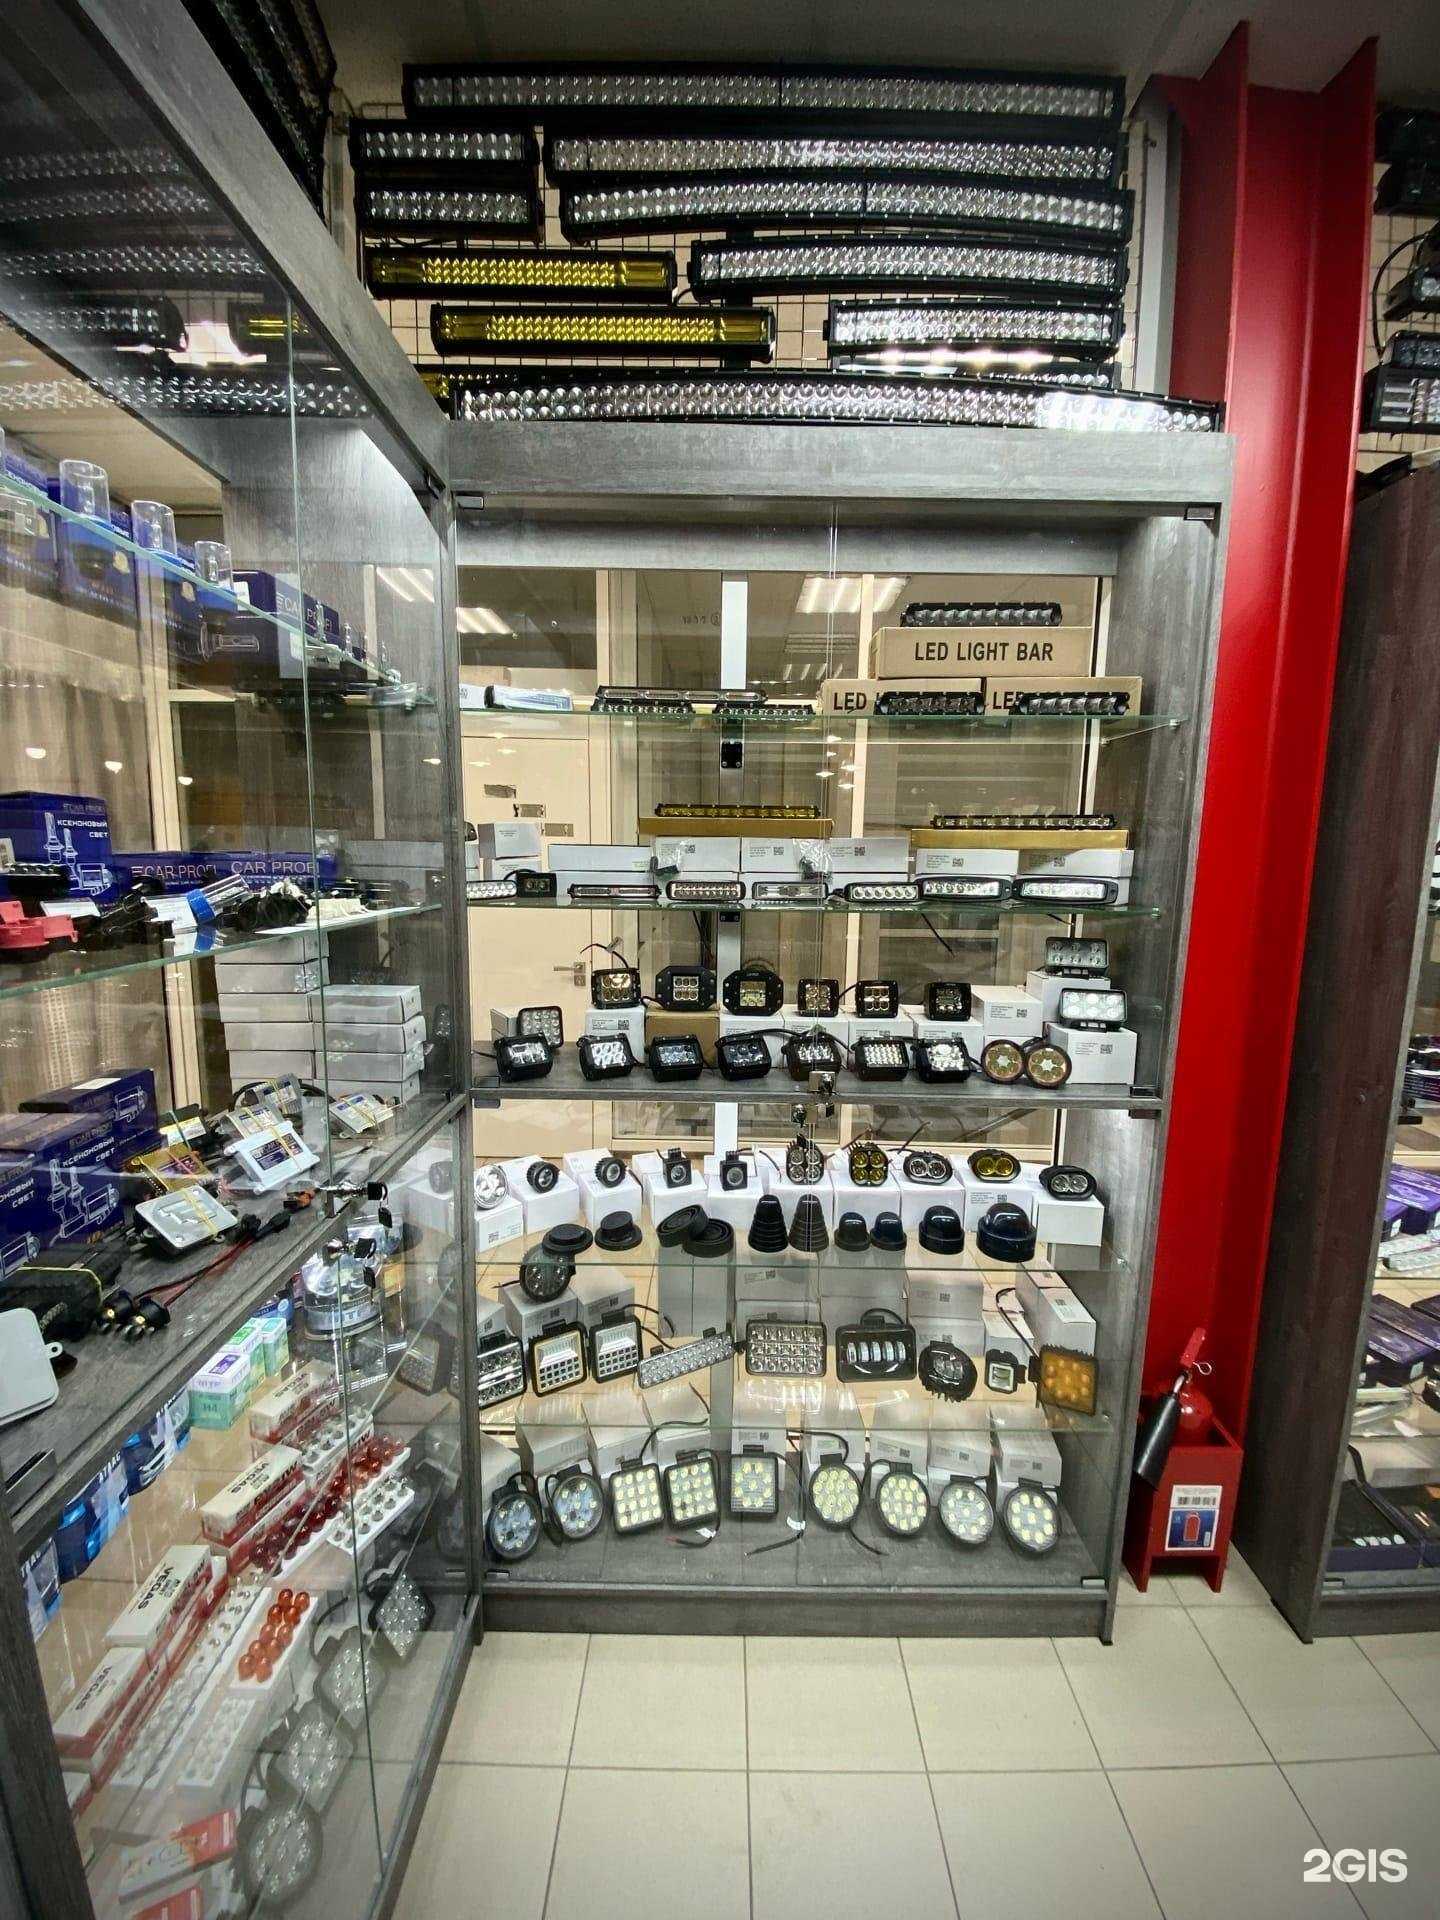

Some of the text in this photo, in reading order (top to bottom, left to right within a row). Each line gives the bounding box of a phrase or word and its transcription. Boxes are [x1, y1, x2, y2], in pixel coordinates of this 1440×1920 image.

[914, 641, 1053, 661] LED LIGHT BAR
[832, 692, 868, 711] LED
[230, 860, 267, 874] CAR
[95, 1147, 115, 1163] СВЕТ
[137, 1565, 175, 1611] VEGAS
